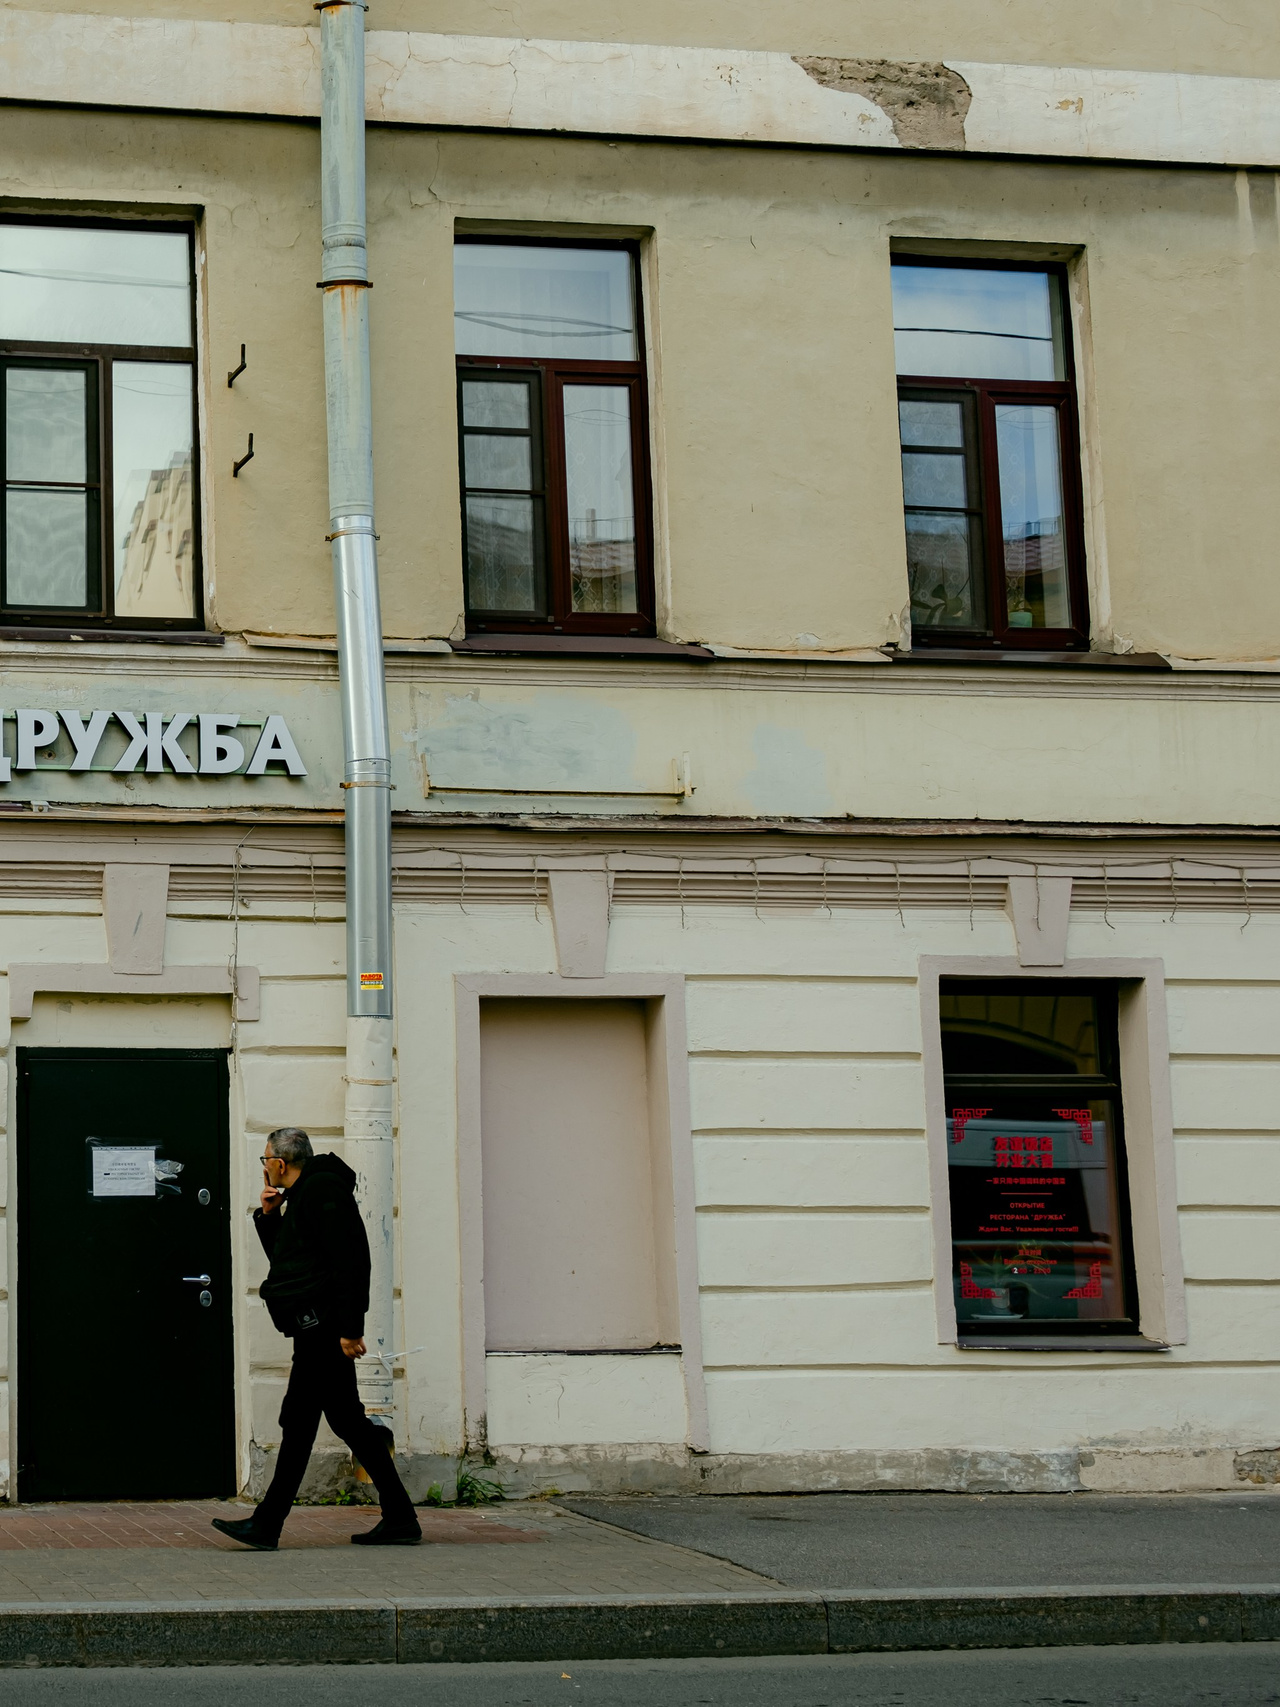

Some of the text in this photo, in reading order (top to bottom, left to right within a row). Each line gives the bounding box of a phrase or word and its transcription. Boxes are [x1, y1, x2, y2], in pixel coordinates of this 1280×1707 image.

[994, 1136, 1053, 1151] 友谊饭店
[995, 1153, 1053, 1168] 开业大吉
[1031, 1213, 1066, 1221] "ДРУЖБА"
